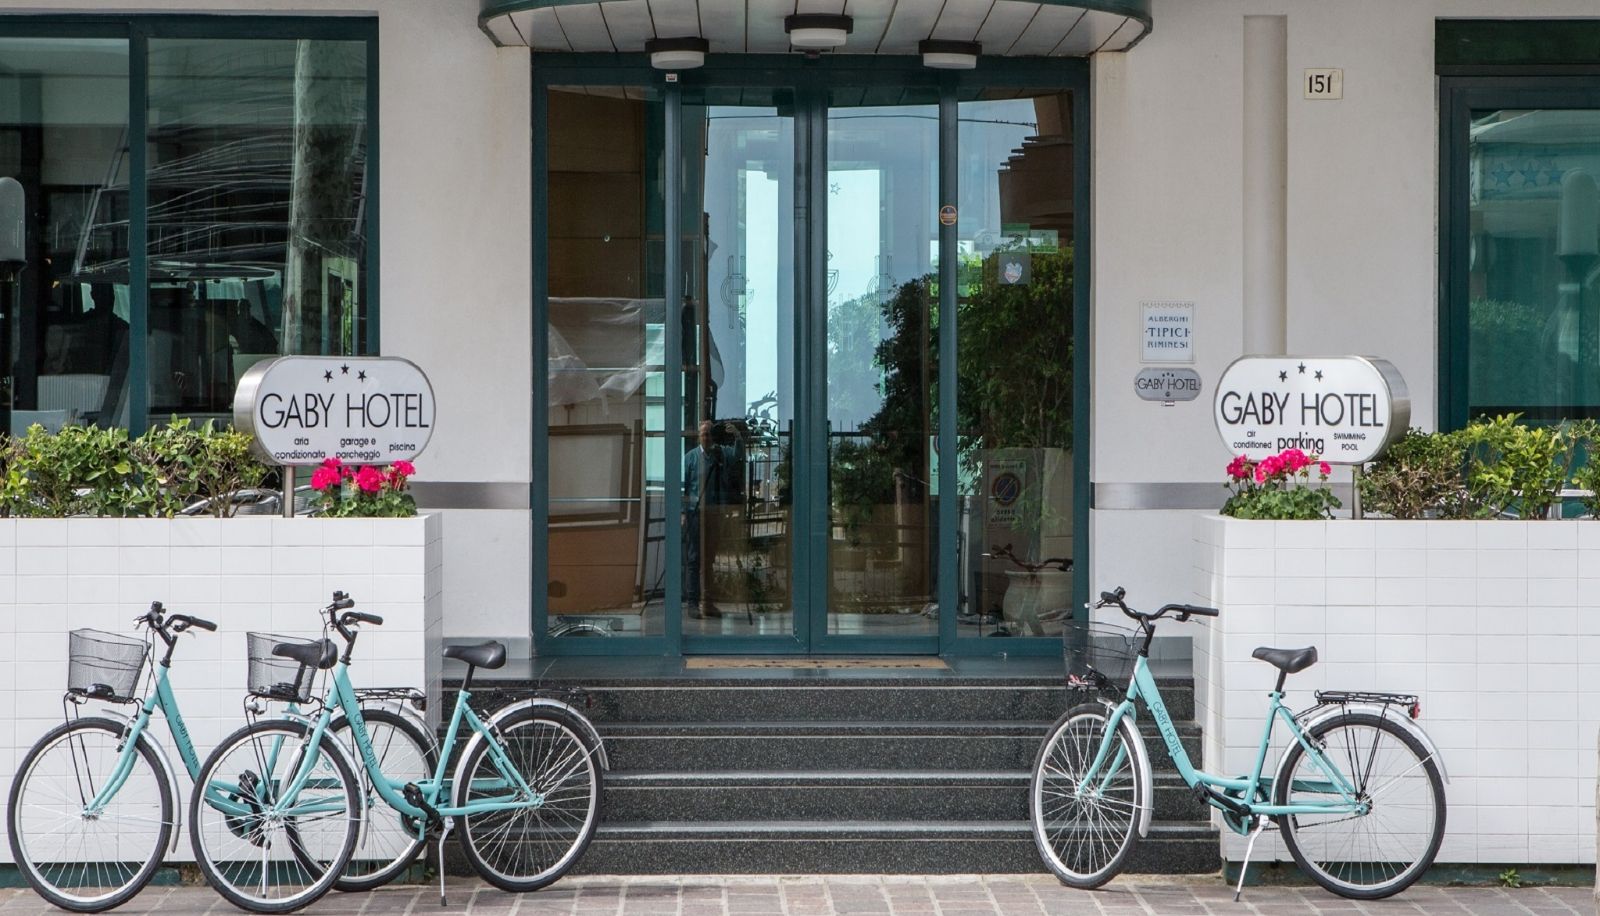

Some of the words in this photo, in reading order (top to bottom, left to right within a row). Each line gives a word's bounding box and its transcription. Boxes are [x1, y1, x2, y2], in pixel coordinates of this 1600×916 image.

[1309, 74, 1331, 93] 151
[1148, 327, 1188, 337] TIPICI
[1137, 378, 1165, 390] GABY
[1168, 378, 1199, 391] HOTEL
[260, 393, 335, 428] GABY
[346, 393, 429, 428] HOTEL
[1220, 391, 1290, 425] GABY
[1301, 393, 1384, 427] HOTEL
[294, 437, 309, 446] aria
[340, 437, 370, 448] garage
[371, 438, 376, 446] e
[1233, 440, 1272, 449] conditioned
[1277, 432, 1324, 454] parking
[1341, 443, 1359, 451] POOL
[389, 443, 416, 453] piscina
[274, 449, 326, 459] condizionata
[336, 449, 380, 460] parcheggio
[1153, 701, 1169, 726] GABY
[1165, 727, 1182, 757] HOTEL
[354, 713, 368, 738] GABY
[363, 739, 377, 768] HOTEL
